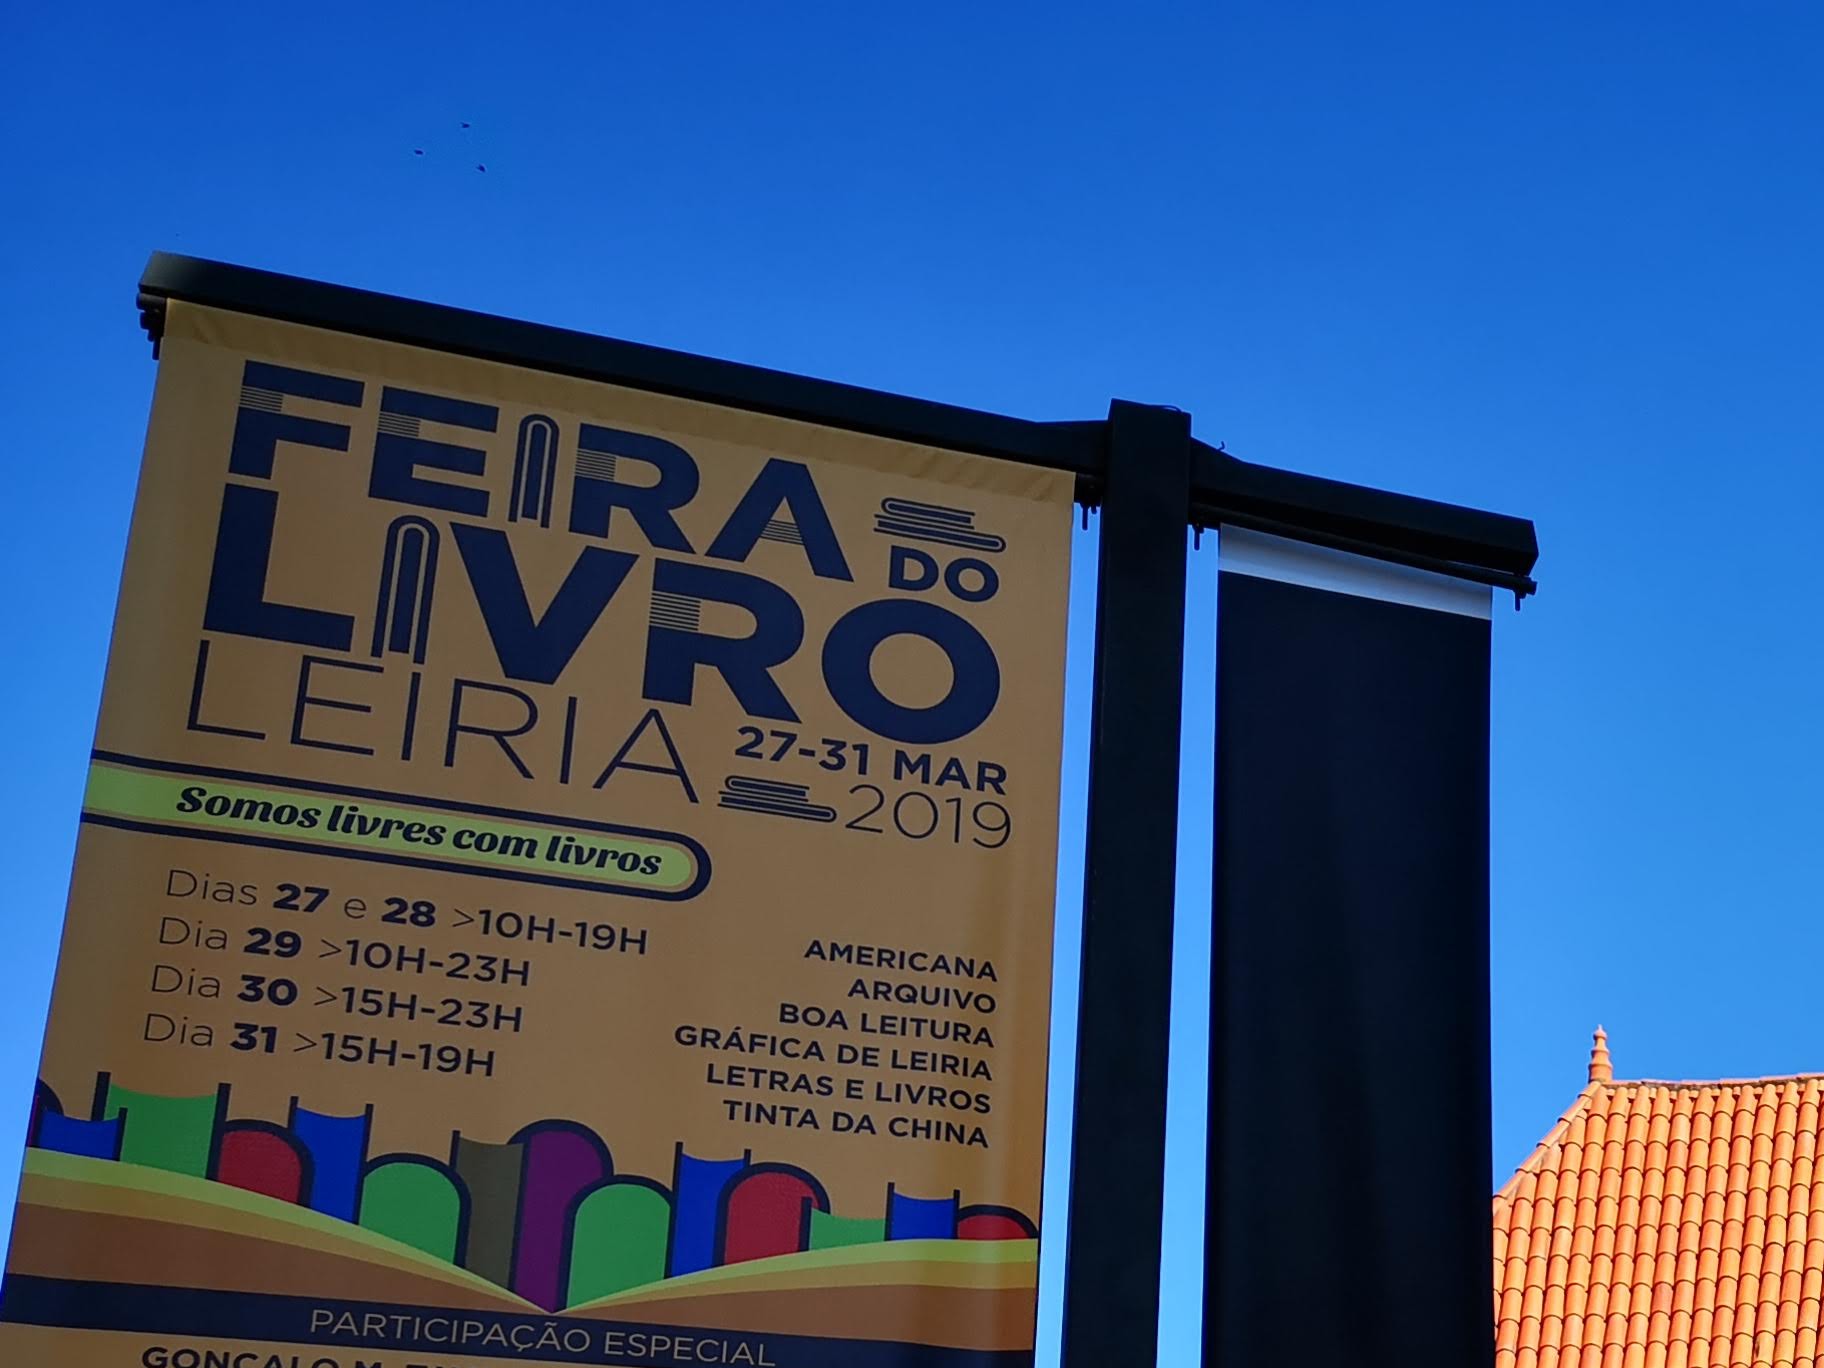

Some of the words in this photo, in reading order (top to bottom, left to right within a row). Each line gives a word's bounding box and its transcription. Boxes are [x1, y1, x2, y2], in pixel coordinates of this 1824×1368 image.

[228, 359, 853, 583] FEIRA
[889, 545, 999, 603] DO
[203, 483, 1001, 745] LIVRO
[187, 639, 700, 804] LEIRIA
[735, 726, 872, 776] 27-31
[893, 748, 1009, 795] MAR
[176, 783, 320, 830] Somos
[327, 804, 446, 850] livres
[453, 823, 540, 862] com
[547, 831, 662, 878] livros
[845, 785, 1011, 848] 2019
[166, 869, 258, 906] Dias
[273, 883, 330, 913] 27
[343, 898, 367, 919] e
[381, 897, 437, 927] 28
[159, 917, 228, 951] Dia
[243, 927, 301, 959] 29
[804, 939, 998, 982] AMERICANA
[151, 964, 222, 999] Dia
[237, 974, 299, 1006] 30
[847, 978, 997, 1014] ARQUIVO
[143, 1012, 215, 1047] Dia
[229, 1022, 279, 1054] 31
[674, 1025, 826, 1062] GRÁFICA
[837, 1043, 880, 1067] DE
[891, 1049, 993, 1081] LEIRIA
[779, 1003, 848, 1030] BOA
[860, 1013, 995, 1048] LEITURA
[706, 1063, 834, 1097] LETRAS
[845, 1079, 865, 1100] E
[875, 1082, 991, 1115] LIVROS
[723, 1099, 820, 1130] TINTA
[832, 1111, 877, 1136] DA
[888, 1117, 989, 1149] CHINA
[310, 1308, 591, 1353] PARTICIPAÇÃO
[603, 1331, 777, 1368] ESPECIAL
